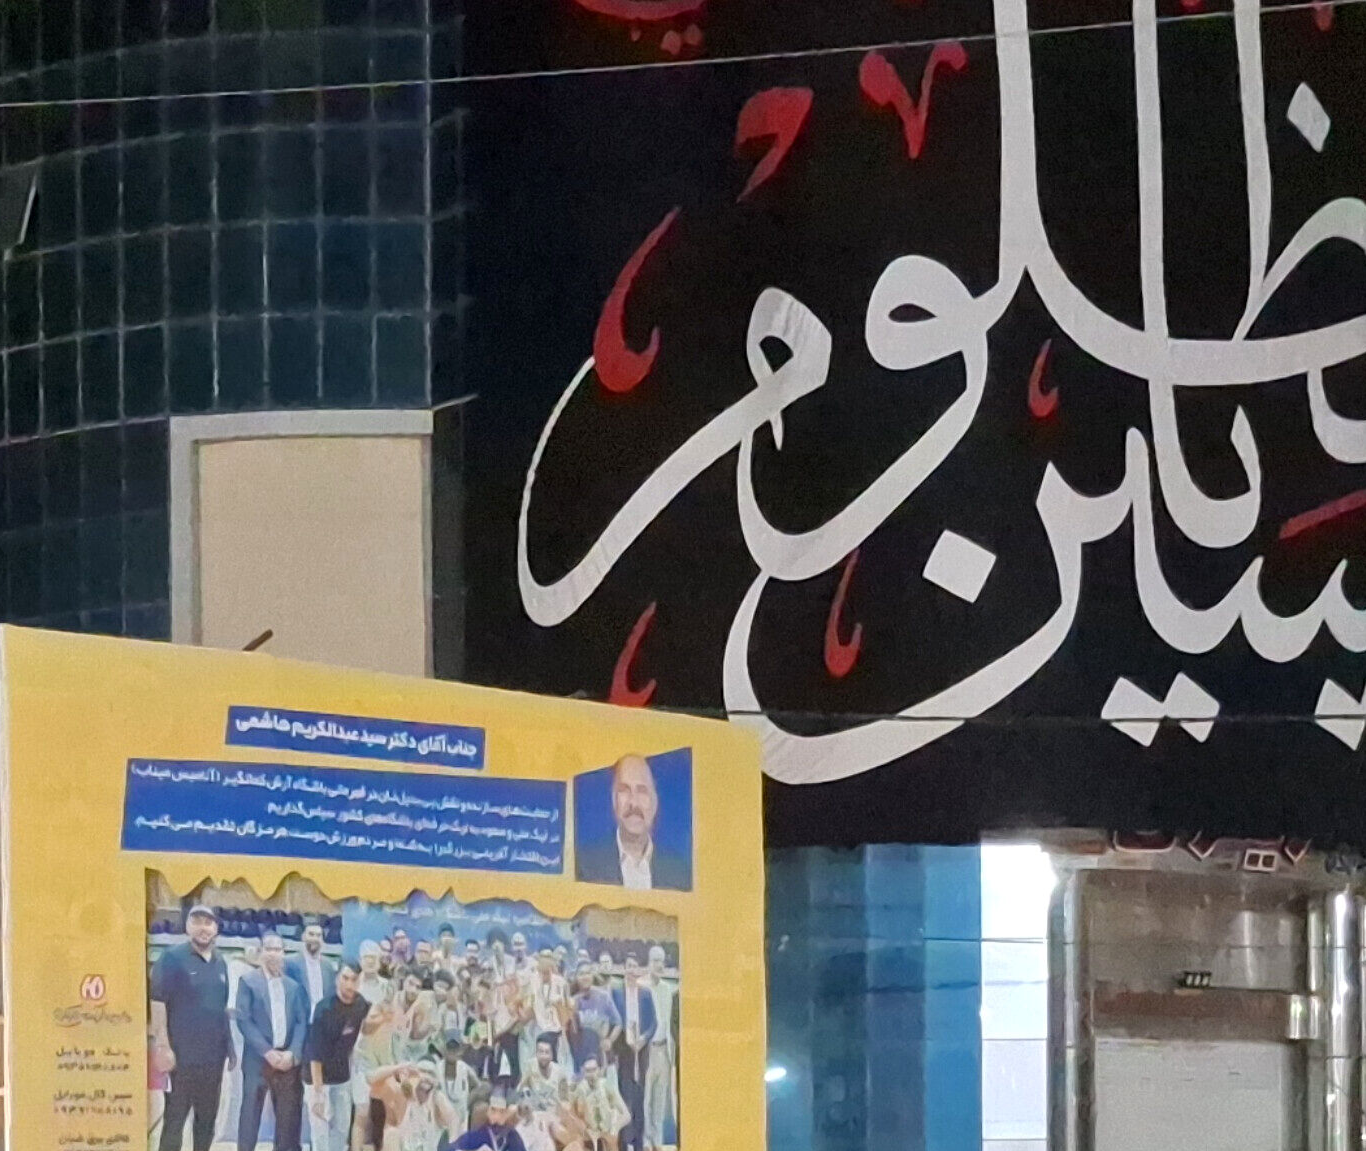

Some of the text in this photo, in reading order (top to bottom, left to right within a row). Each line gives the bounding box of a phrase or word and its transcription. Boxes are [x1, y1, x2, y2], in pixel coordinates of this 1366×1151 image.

[234, 711, 291, 732] هاشمی
[291, 719, 360, 742] عبدالکریم
[387, 731, 417, 750] دکتر
[417, 735, 447, 755] آقای
[448, 743, 478, 760] جناب
